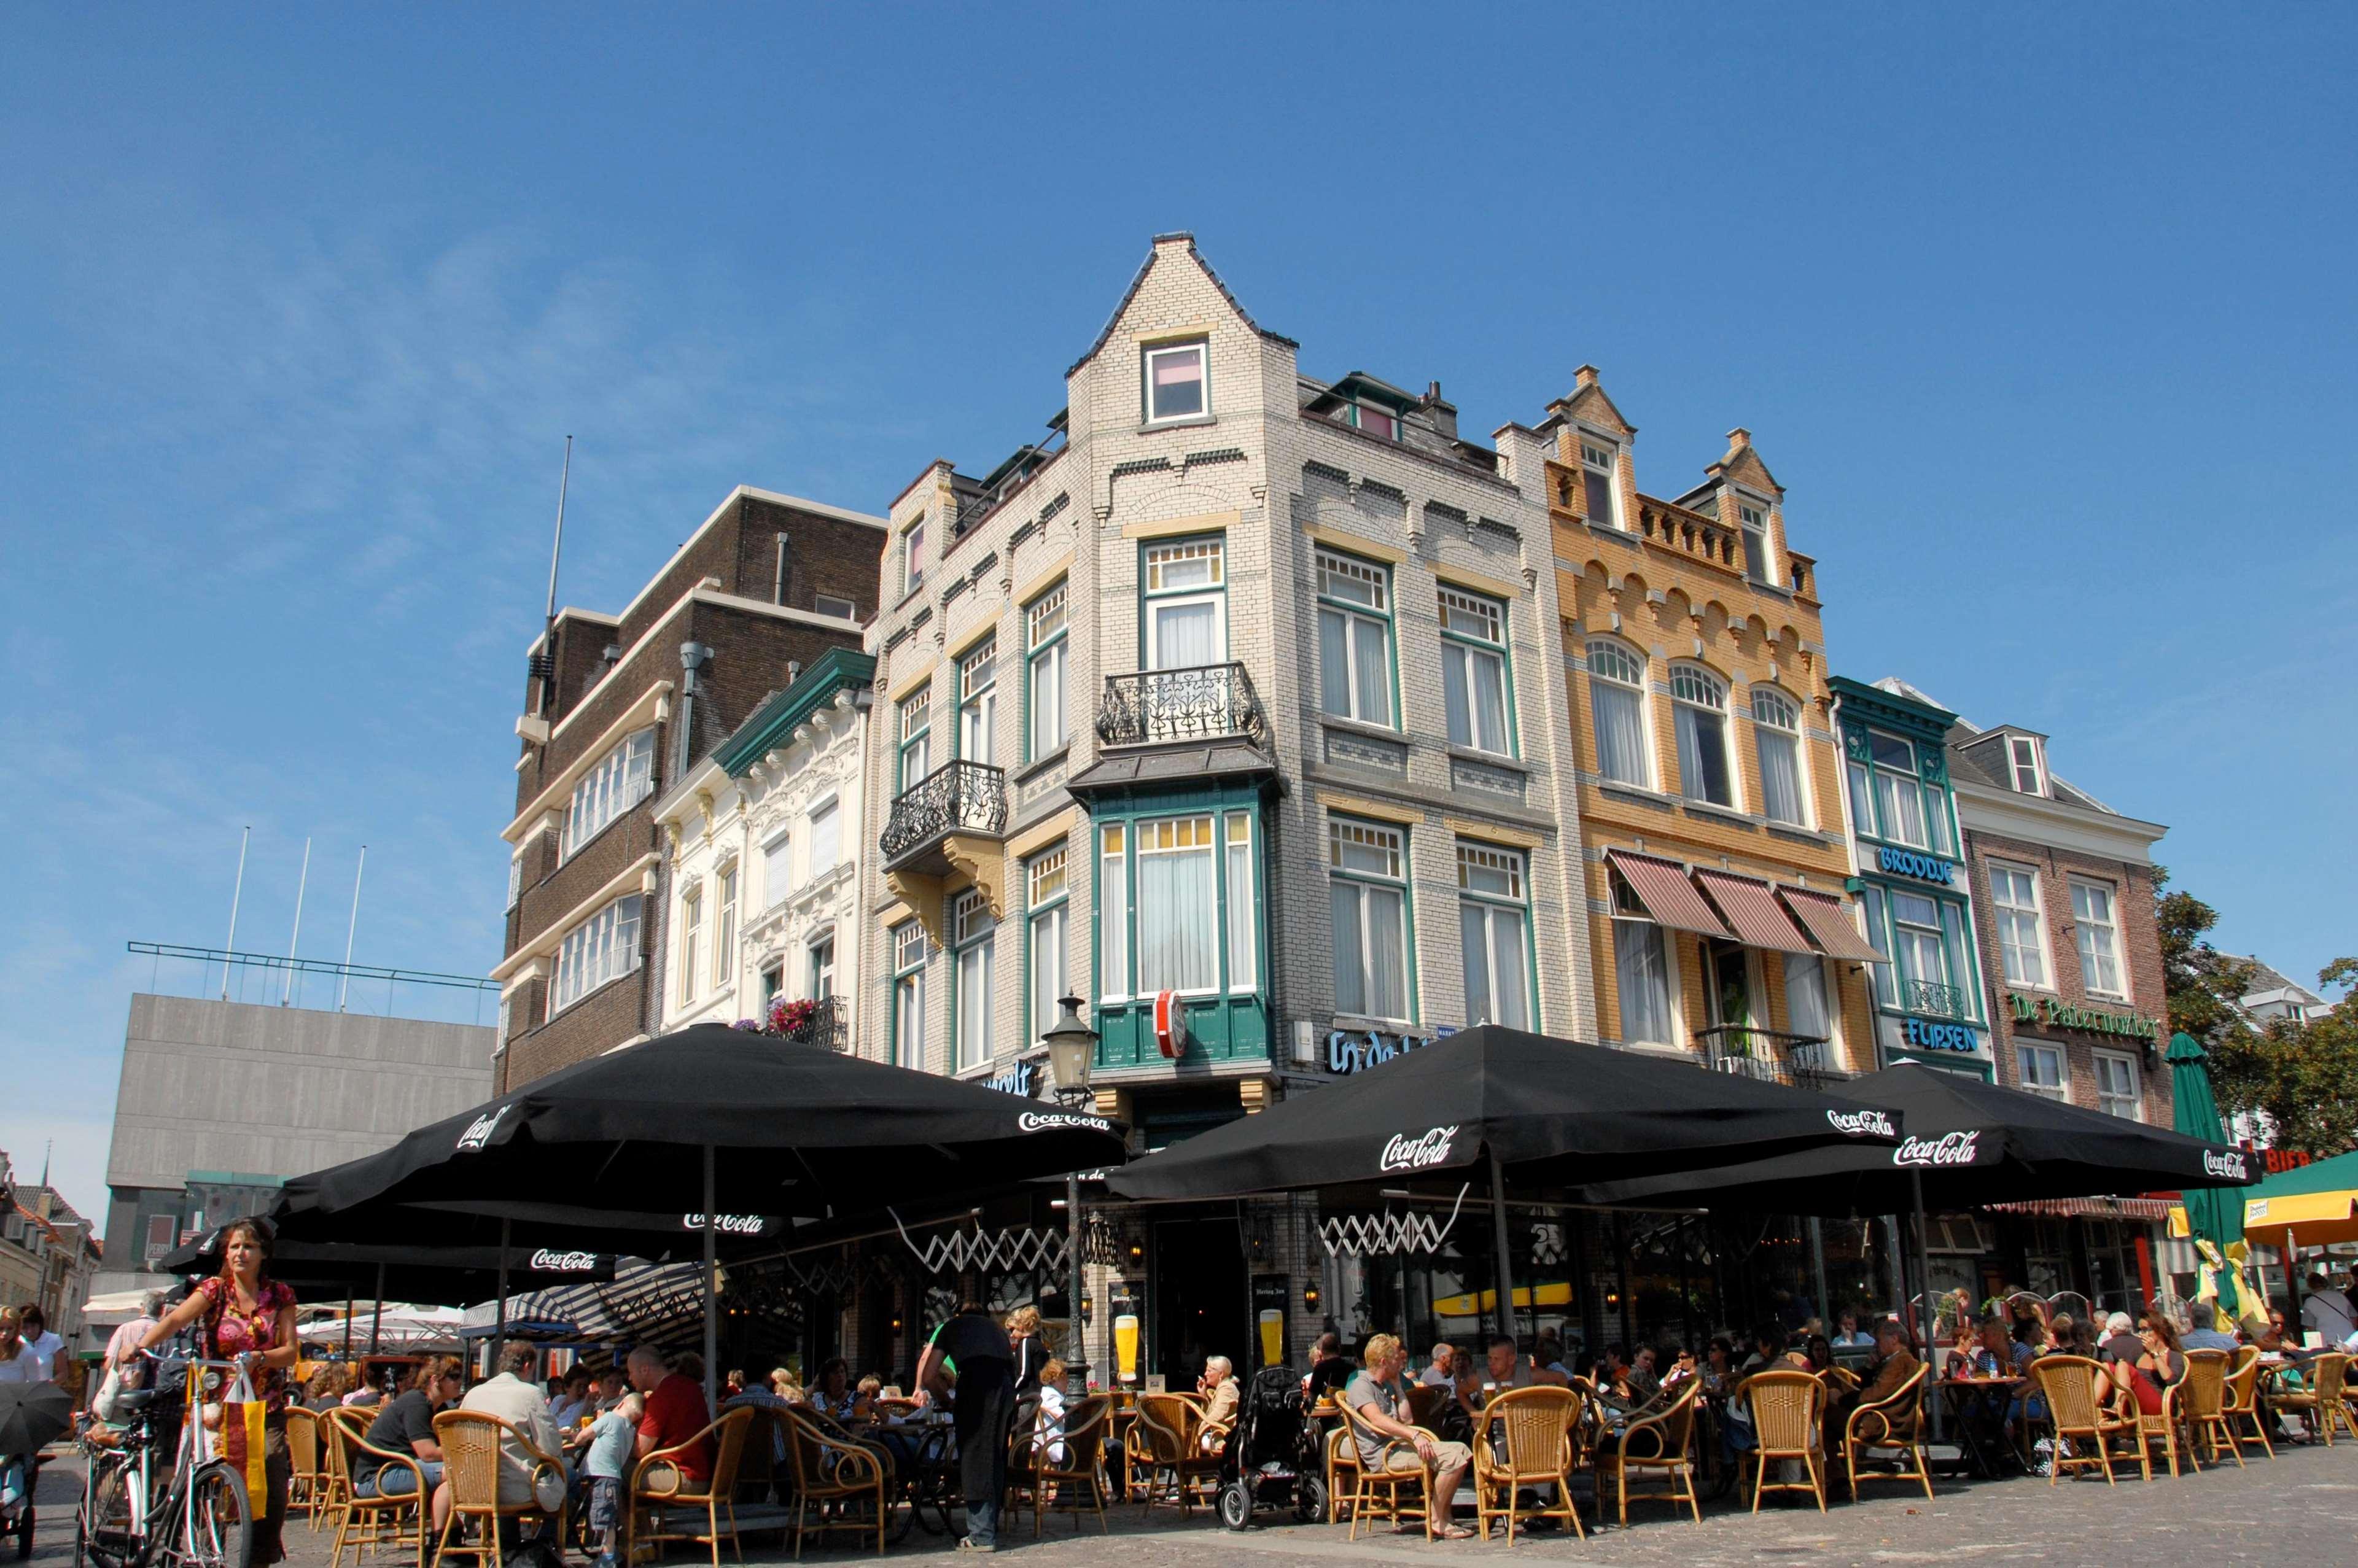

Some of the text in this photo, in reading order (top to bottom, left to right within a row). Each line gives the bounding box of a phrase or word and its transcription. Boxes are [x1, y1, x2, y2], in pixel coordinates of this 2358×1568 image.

[1880, 847, 1955, 885] BROODJE
[2010, 992, 2039, 1022] De
[1907, 1017, 1978, 1052] FLIPSEN
